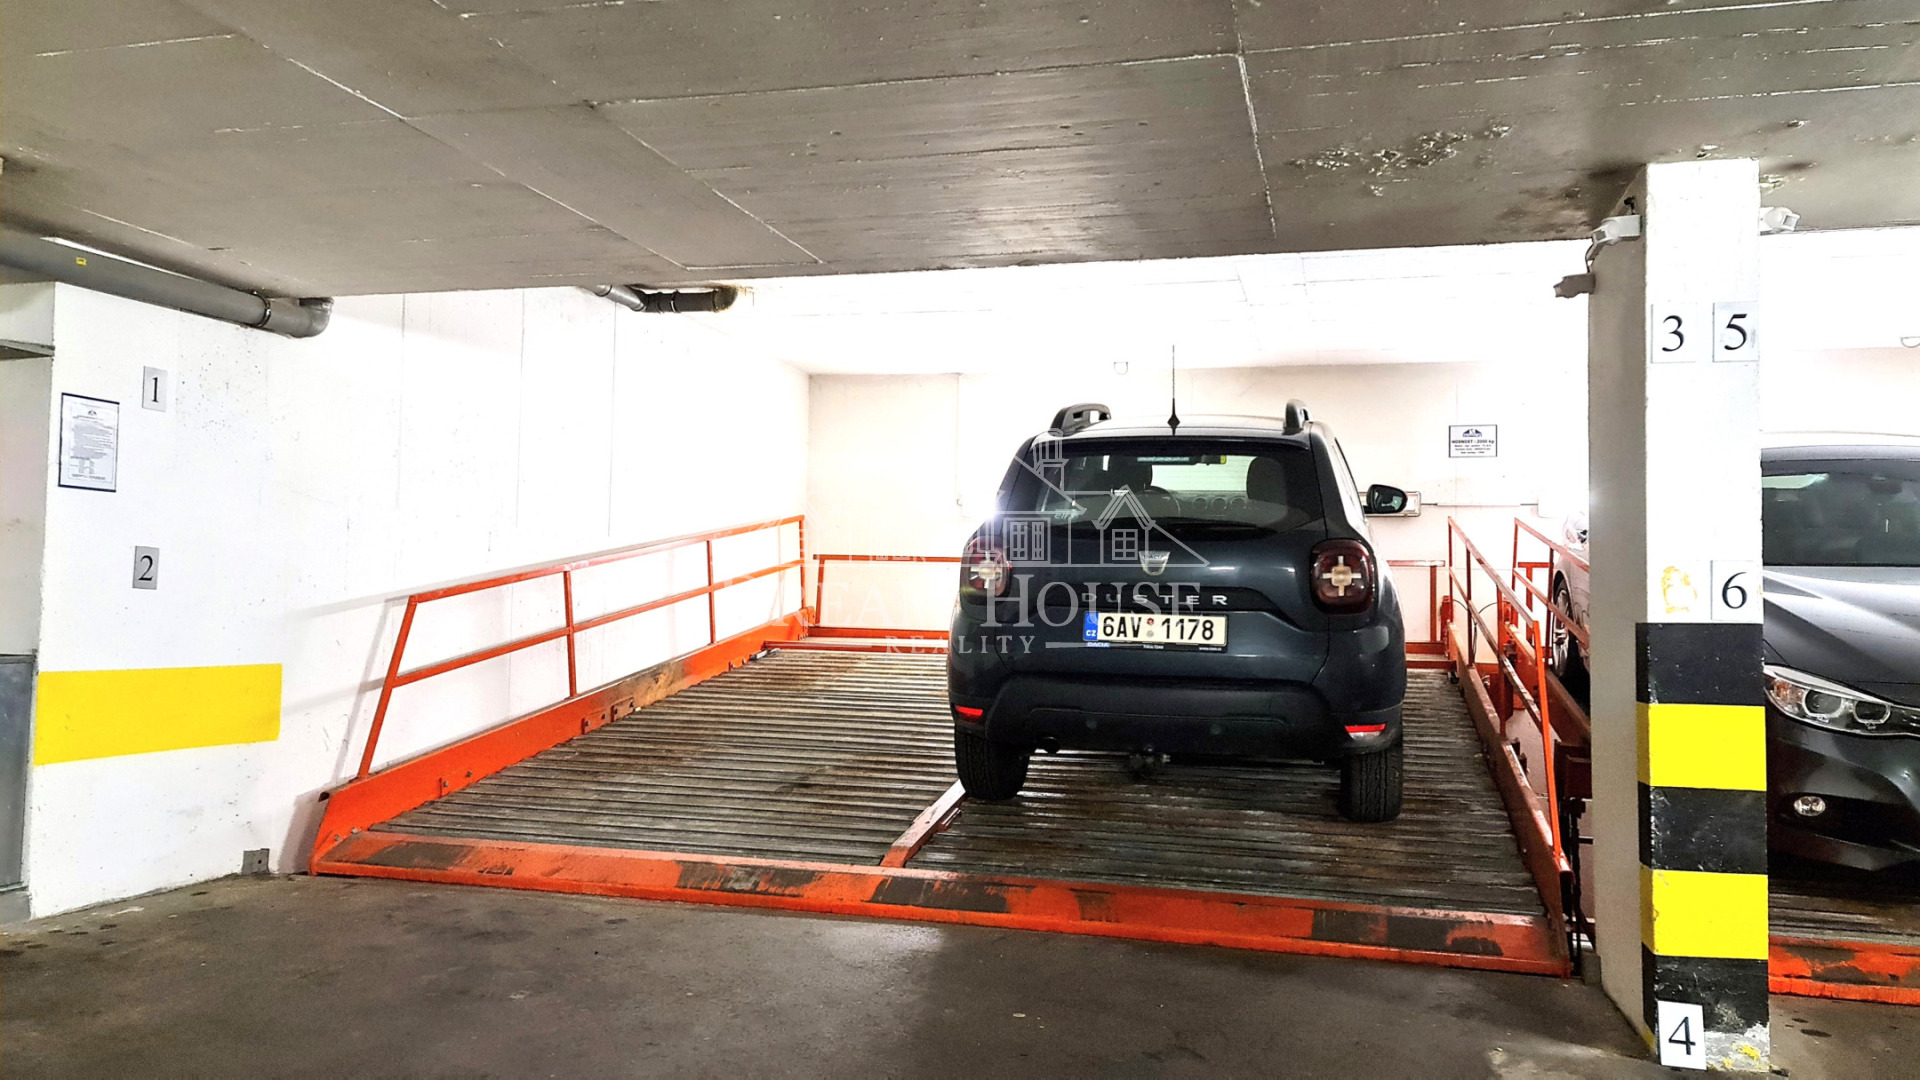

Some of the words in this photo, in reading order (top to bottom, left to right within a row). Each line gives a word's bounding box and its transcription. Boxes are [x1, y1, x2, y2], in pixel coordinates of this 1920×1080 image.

[1661, 315, 1685, 352] 3
[1723, 313, 1748, 351] 5
[152, 376, 159, 403] 1
[137, 555, 154, 582] 2
[1081, 592, 1229, 606] DUSTER
[1721, 571, 1748, 609] 6
[1085, 629, 1097, 637] CZ
[1102, 616, 1142, 638] 6AV
[1161, 617, 1214, 641] 1178
[1668, 1016, 1696, 1056] 4
